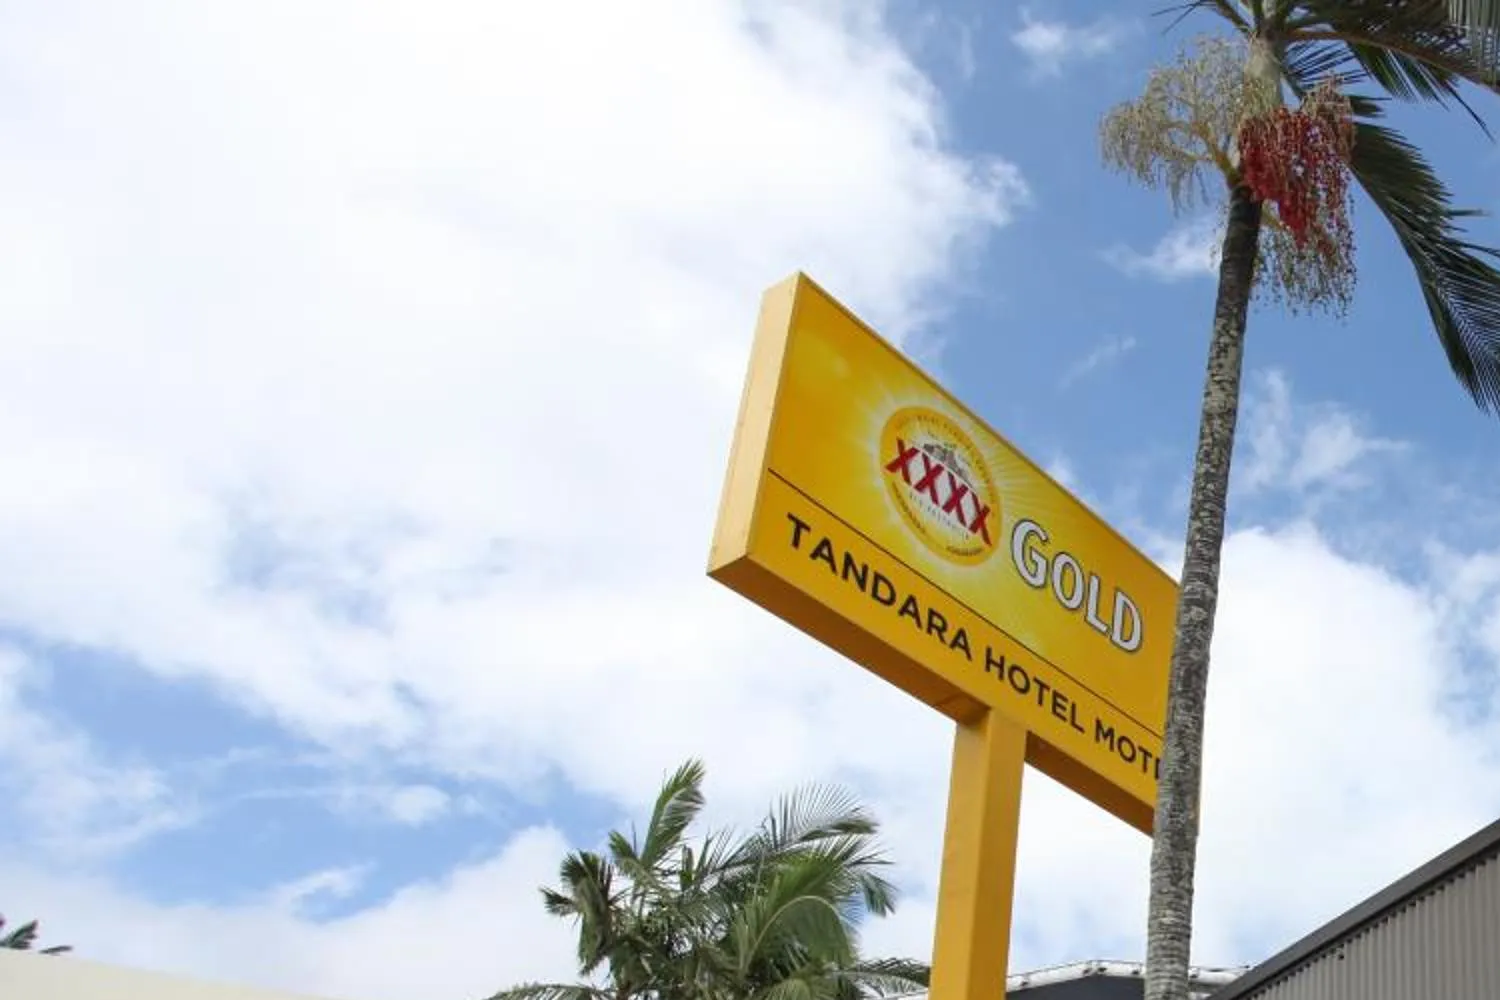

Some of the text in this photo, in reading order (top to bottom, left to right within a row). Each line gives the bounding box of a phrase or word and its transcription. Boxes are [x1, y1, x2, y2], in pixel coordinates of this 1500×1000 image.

[884, 437, 992, 547] XXXX
[786, 512, 974, 661] TANDARA
[984, 646, 1085, 734] HOTEL
[1010, 518, 1144, 654] GOLD
